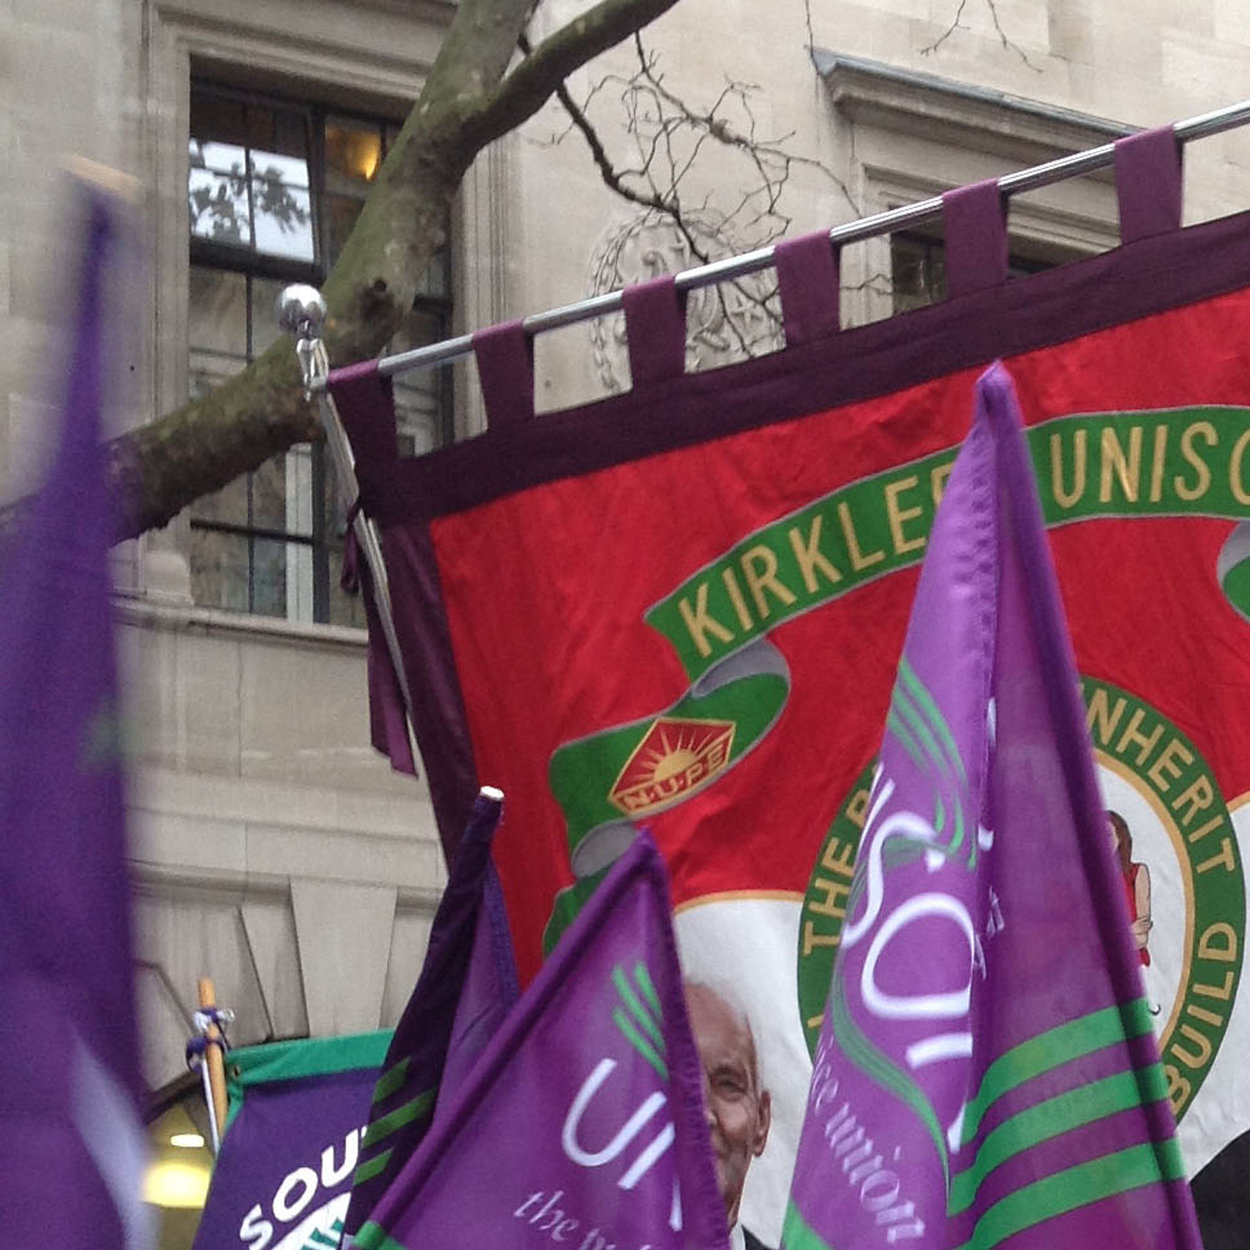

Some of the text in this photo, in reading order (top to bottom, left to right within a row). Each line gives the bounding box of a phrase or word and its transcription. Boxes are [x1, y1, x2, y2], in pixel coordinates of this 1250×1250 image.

[677, 462, 956, 658] KIRKLE
[1079, 682, 1236, 875] NHERIT
[803, 836, 857, 956] THE
[1164, 921, 1238, 1116] BUILD
[513, 1189, 578, 1242] the
[824, 1102, 926, 1244] union
